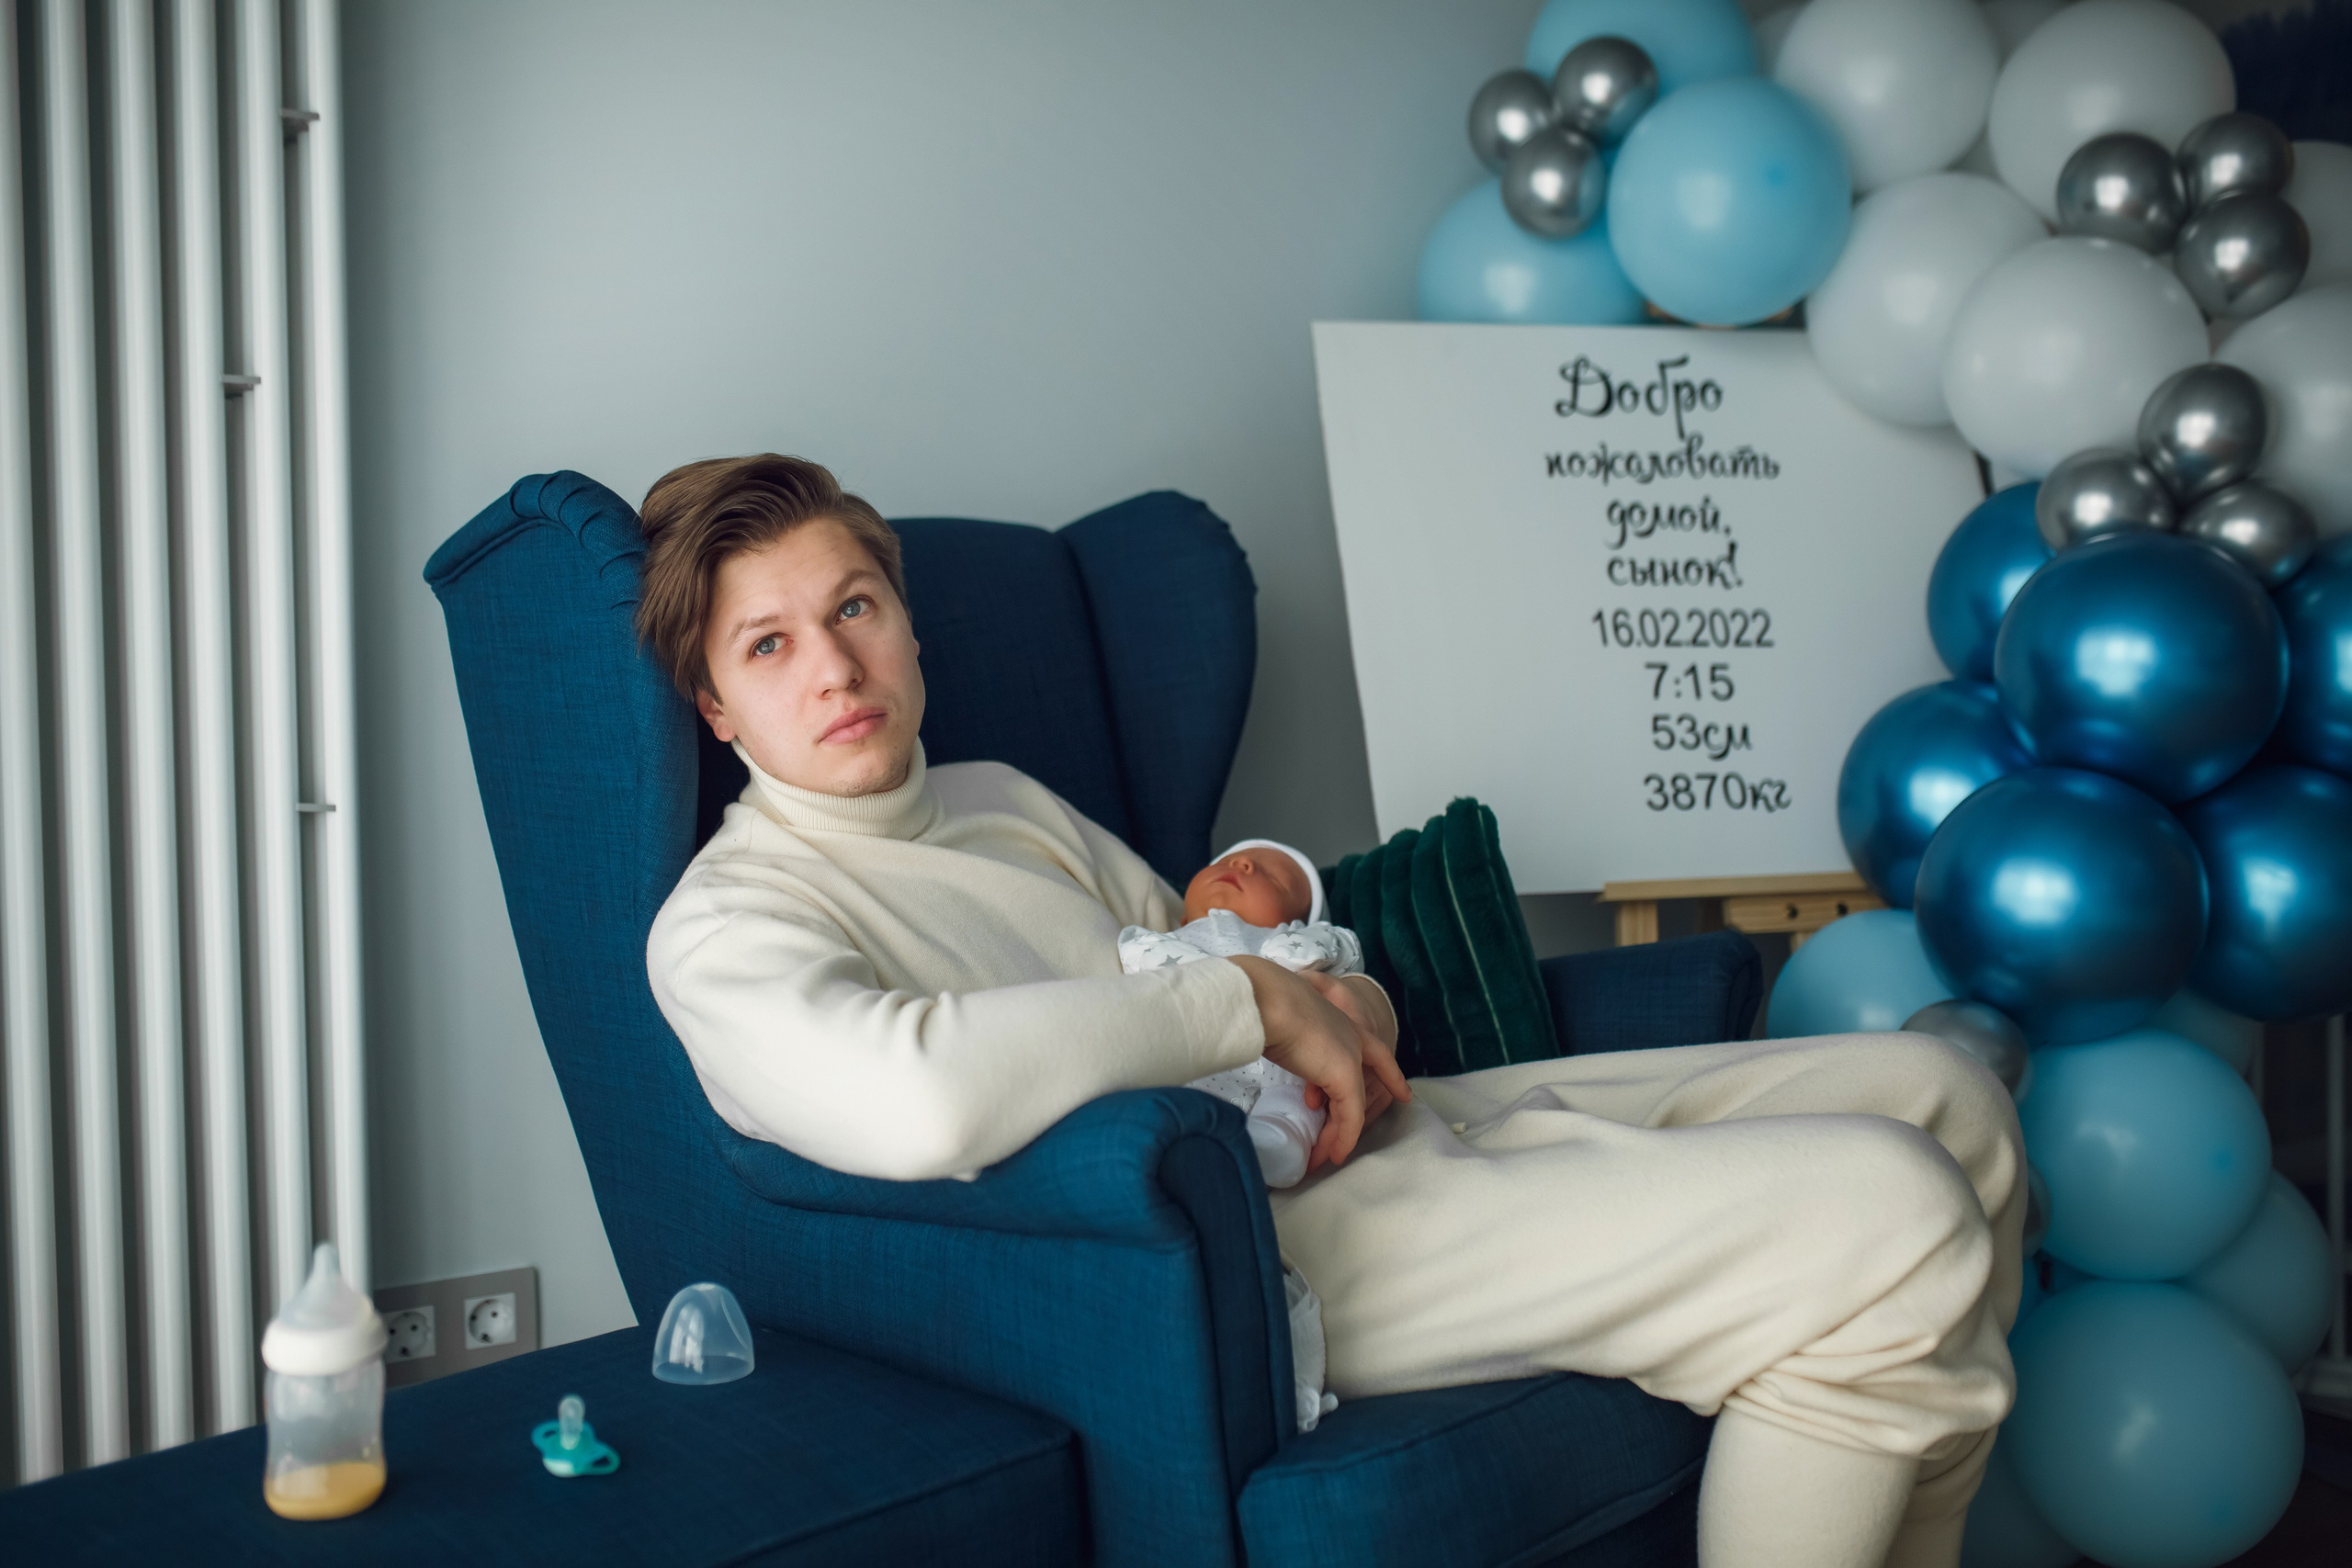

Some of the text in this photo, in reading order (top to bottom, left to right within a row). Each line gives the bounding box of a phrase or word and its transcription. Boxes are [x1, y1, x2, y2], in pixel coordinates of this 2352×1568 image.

[1554, 354, 1724, 439] Добро
[1544, 433, 1781, 486] пожаловать
[1606, 540, 1744, 591] сынок!
[1592, 608, 1774, 649] 16.02.2022
[1645, 661, 1736, 703] 7:15
[1651, 714, 1753, 761] 53см
[1643, 772, 1792, 814] 3870кг
